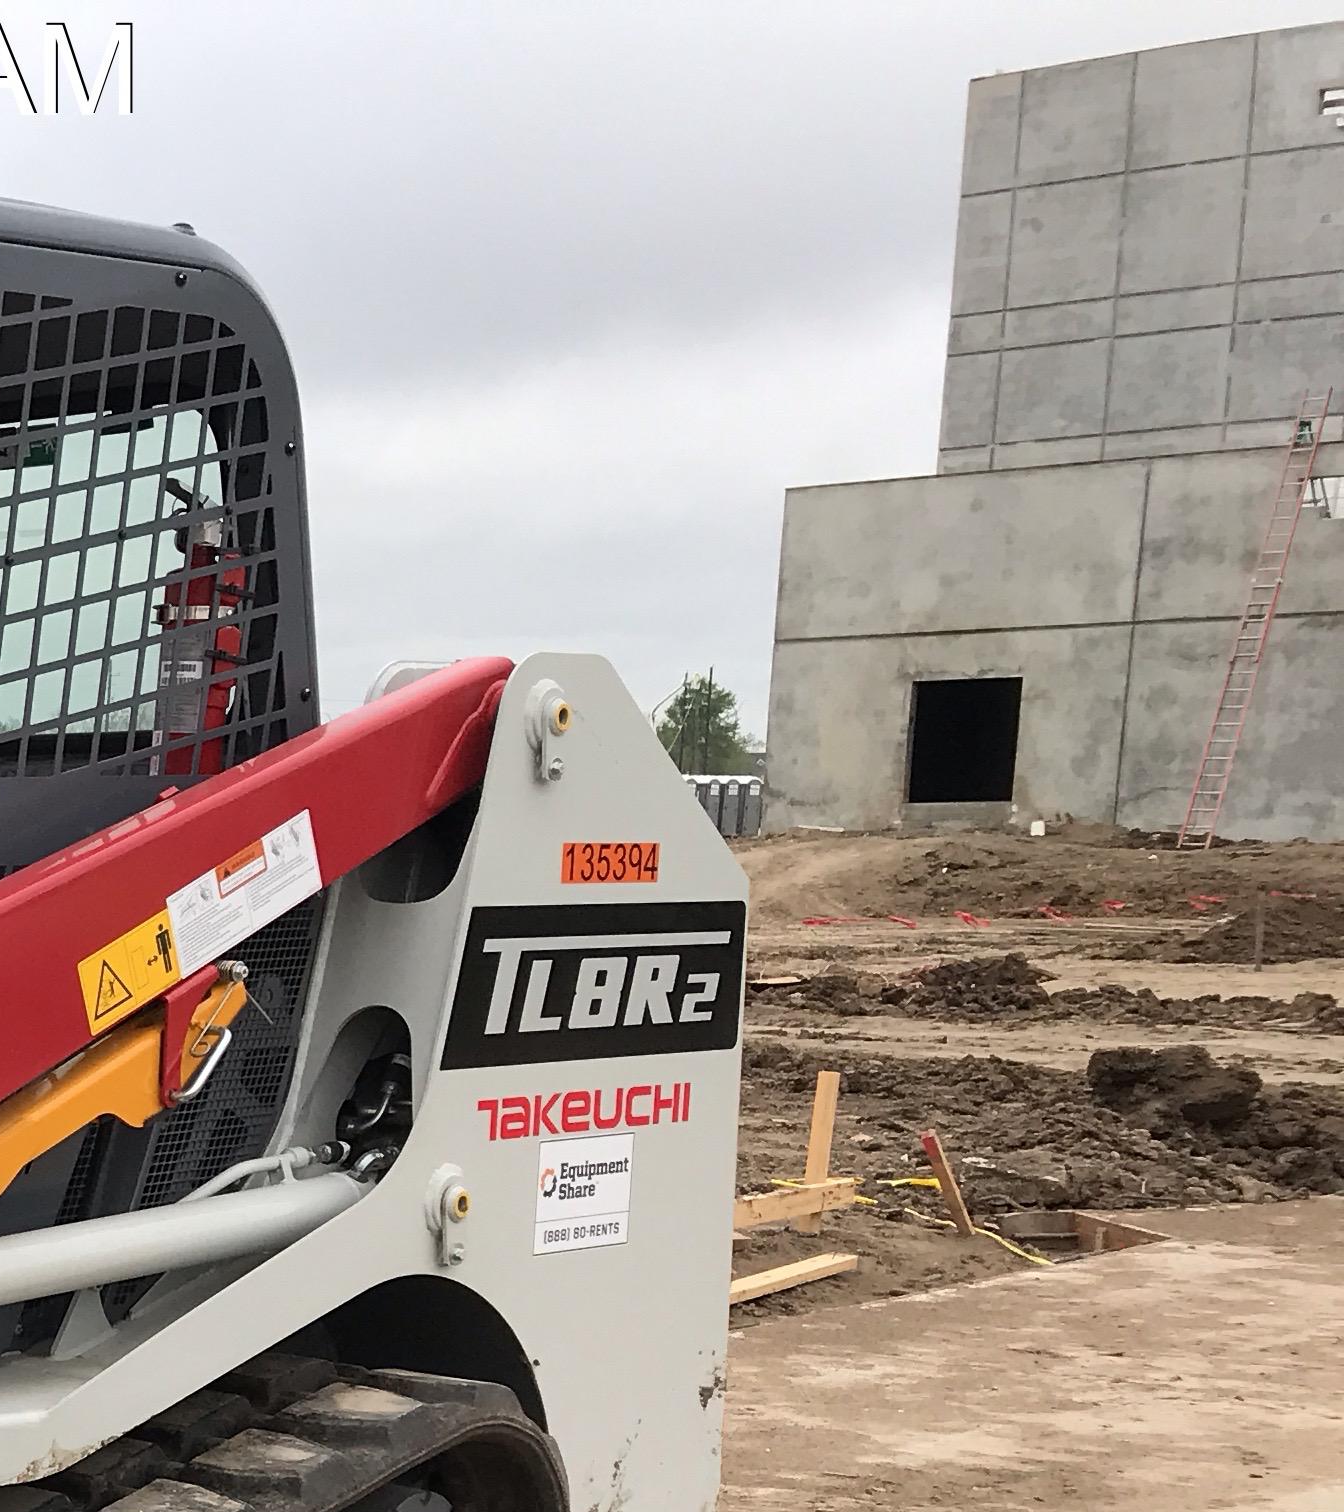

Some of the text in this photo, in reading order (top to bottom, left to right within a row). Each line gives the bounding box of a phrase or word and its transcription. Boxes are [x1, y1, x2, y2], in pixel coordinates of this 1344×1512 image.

[565, 843, 659, 883] 135394
[483, 931, 732, 1036] TL8R2
[477, 1082, 692, 1142] TAKEUCHI
[560, 1157, 629, 1182] Equipment
[558, 1182, 596, 1200] Share
[543, 1227, 570, 1244] (888)
